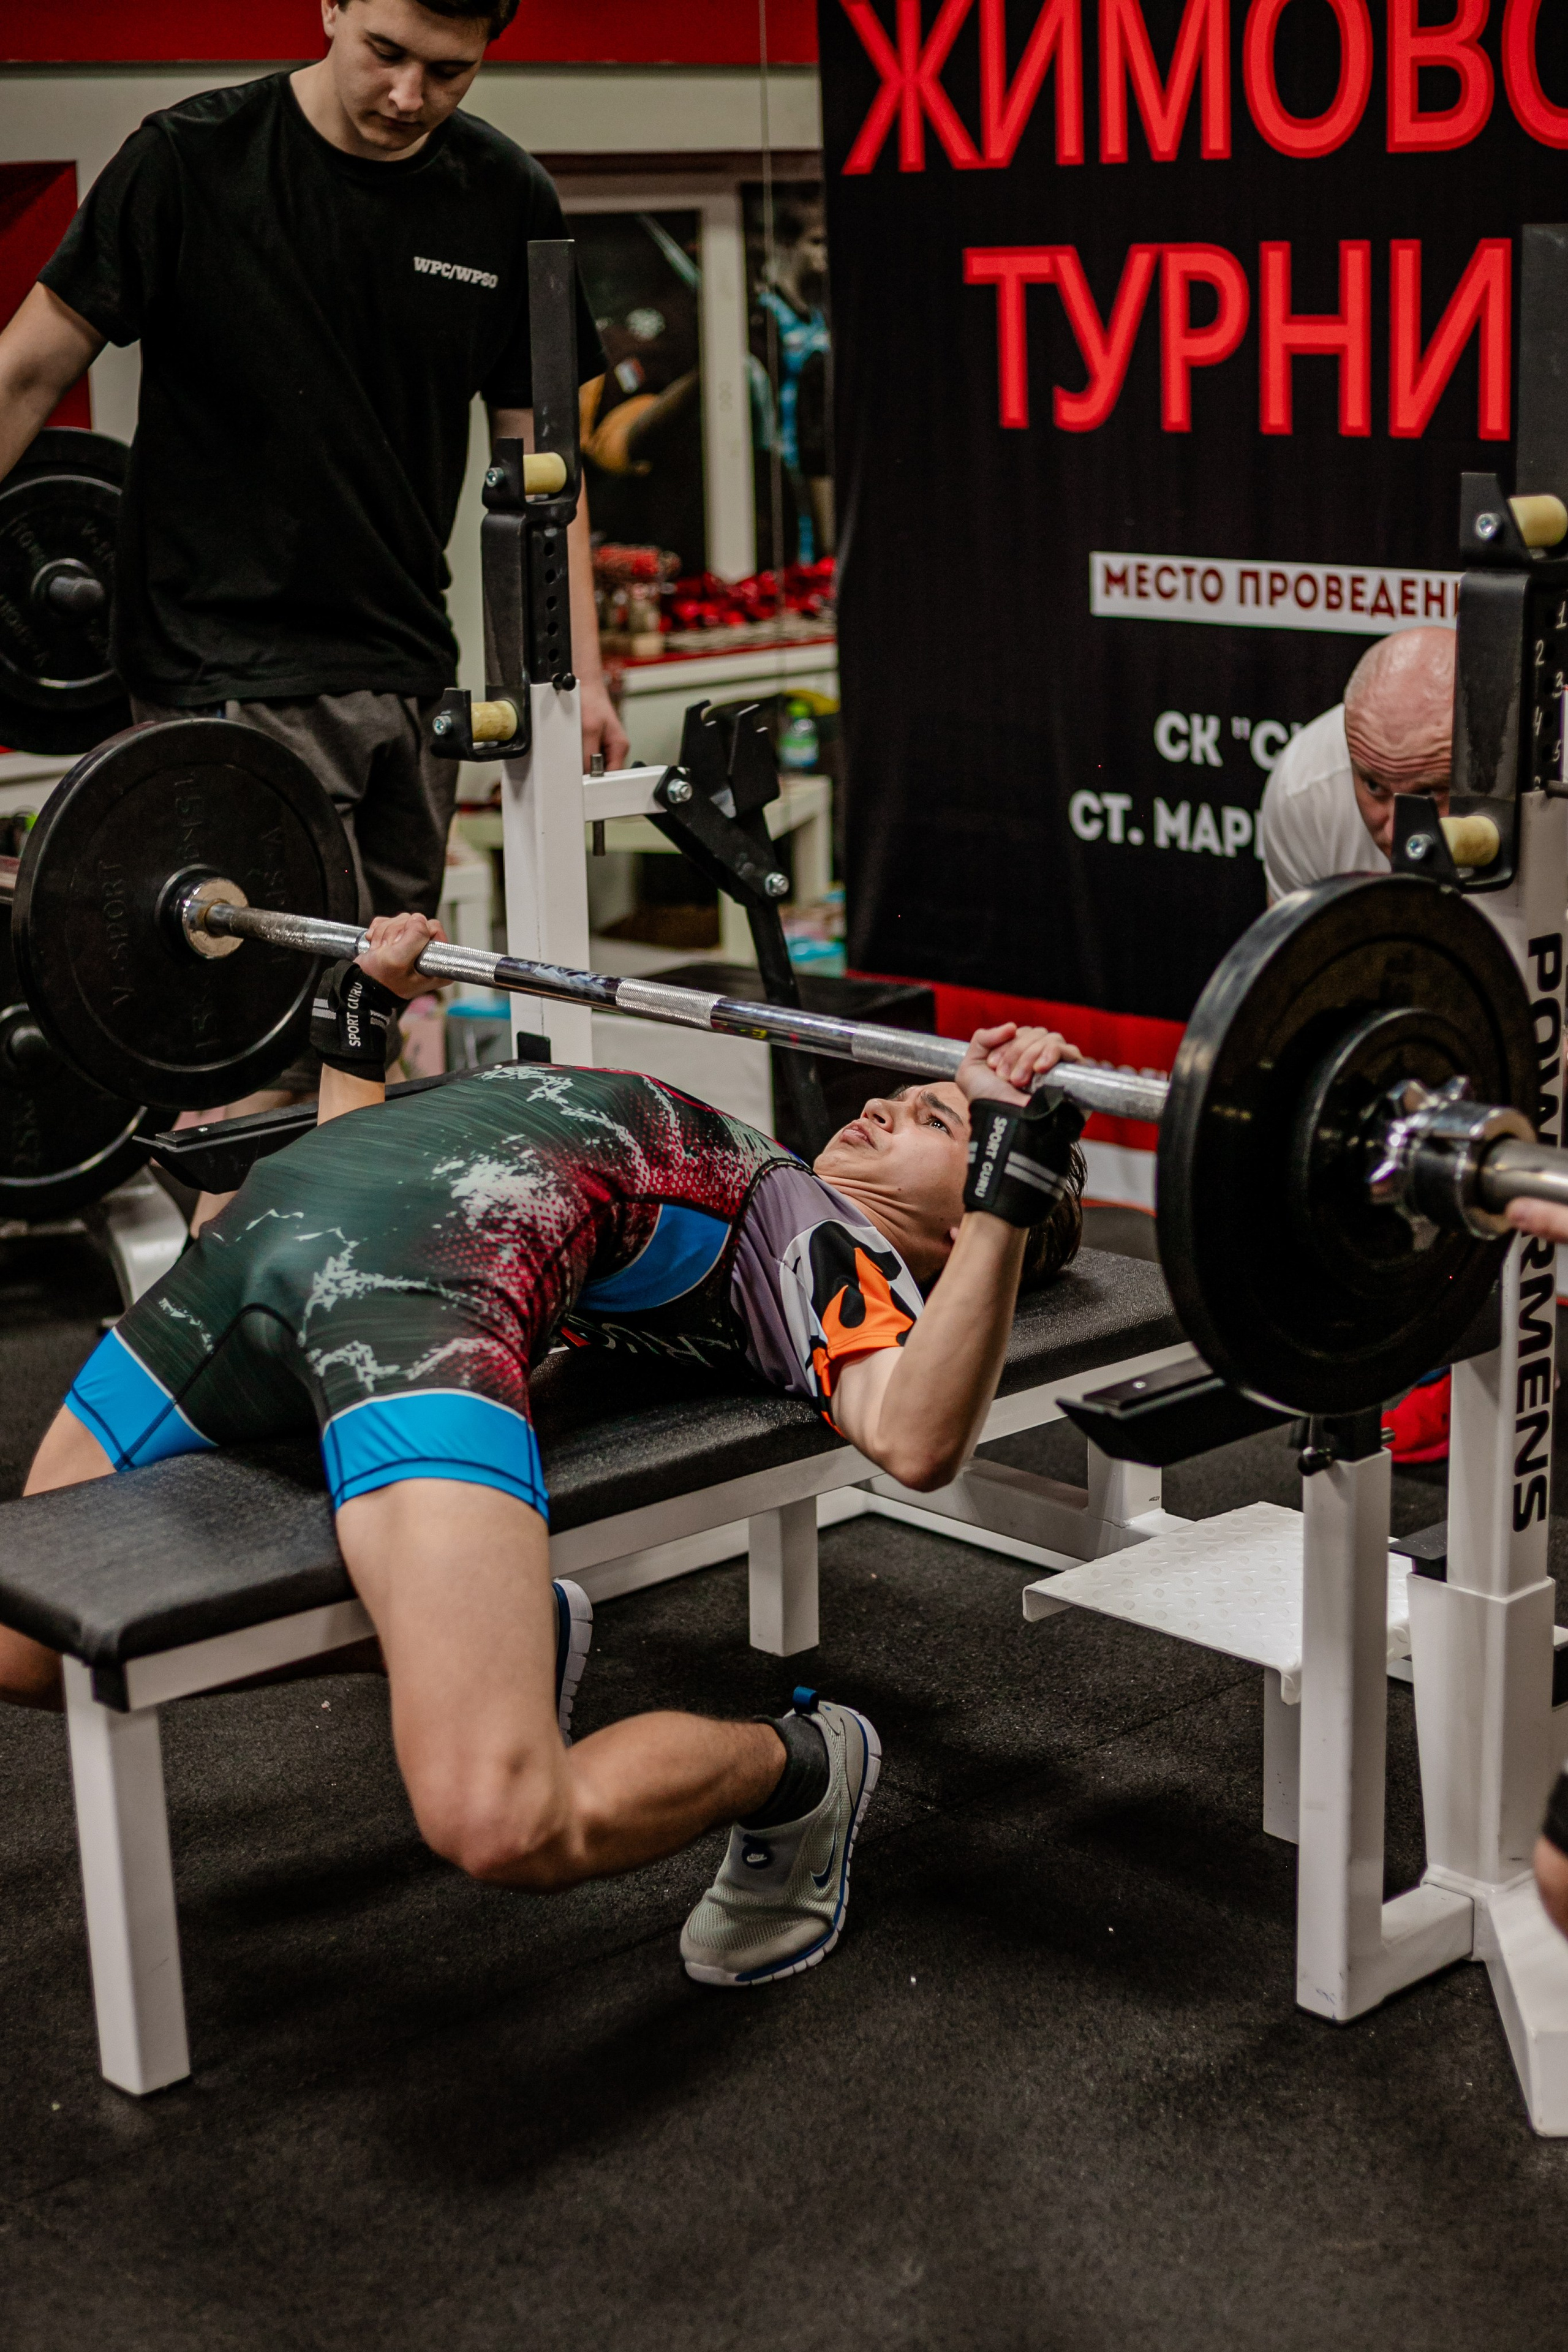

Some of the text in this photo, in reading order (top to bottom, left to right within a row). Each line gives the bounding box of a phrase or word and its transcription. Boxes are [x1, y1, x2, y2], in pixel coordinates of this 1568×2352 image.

[1104, 564, 1224, 603] МЕСТО
[1535, 639, 1544, 666] 2
[1154, 710, 1303, 771] СК "С
[1069, 789, 1145, 846] СТ.
[347, 982, 363, 1047] SPORT GURU
[974, 1117, 1008, 1198] SPORT GURU
[1513, 932, 1562, 1532] POWRMENS
